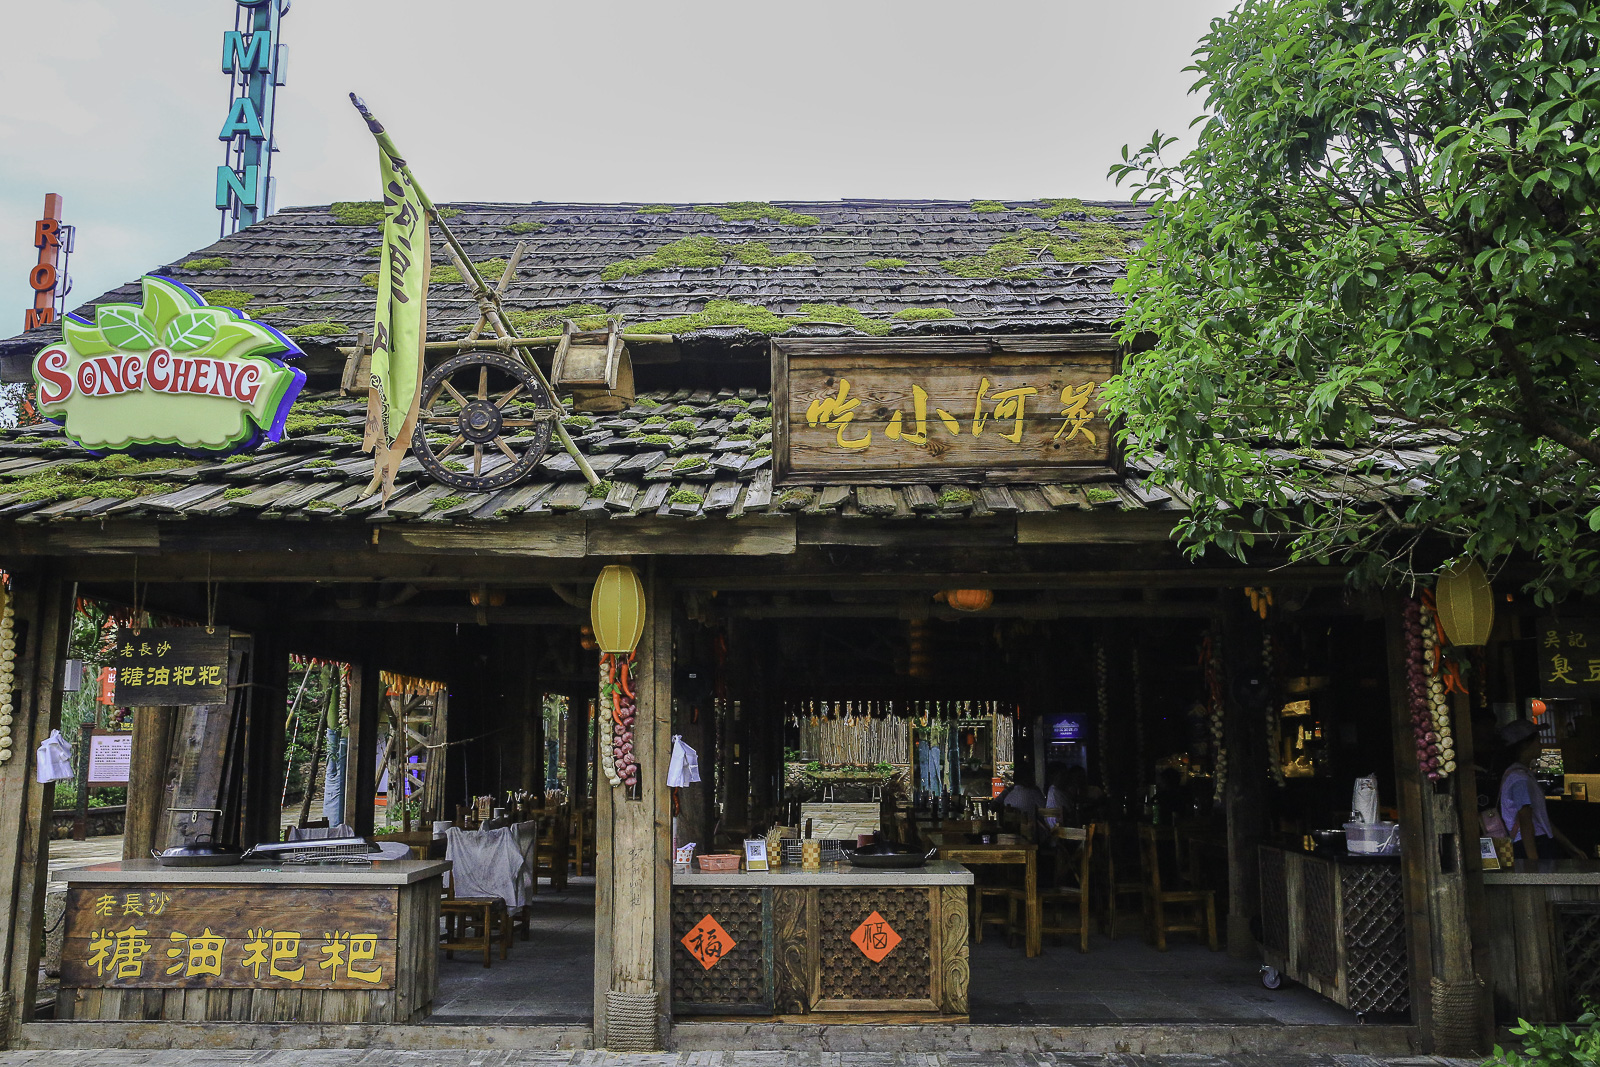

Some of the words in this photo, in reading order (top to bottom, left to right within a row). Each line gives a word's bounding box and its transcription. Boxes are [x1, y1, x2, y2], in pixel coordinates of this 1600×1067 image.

[120, 665, 222, 687] 糖油粑粑
[87, 925, 383, 984] 糖油粑粑
